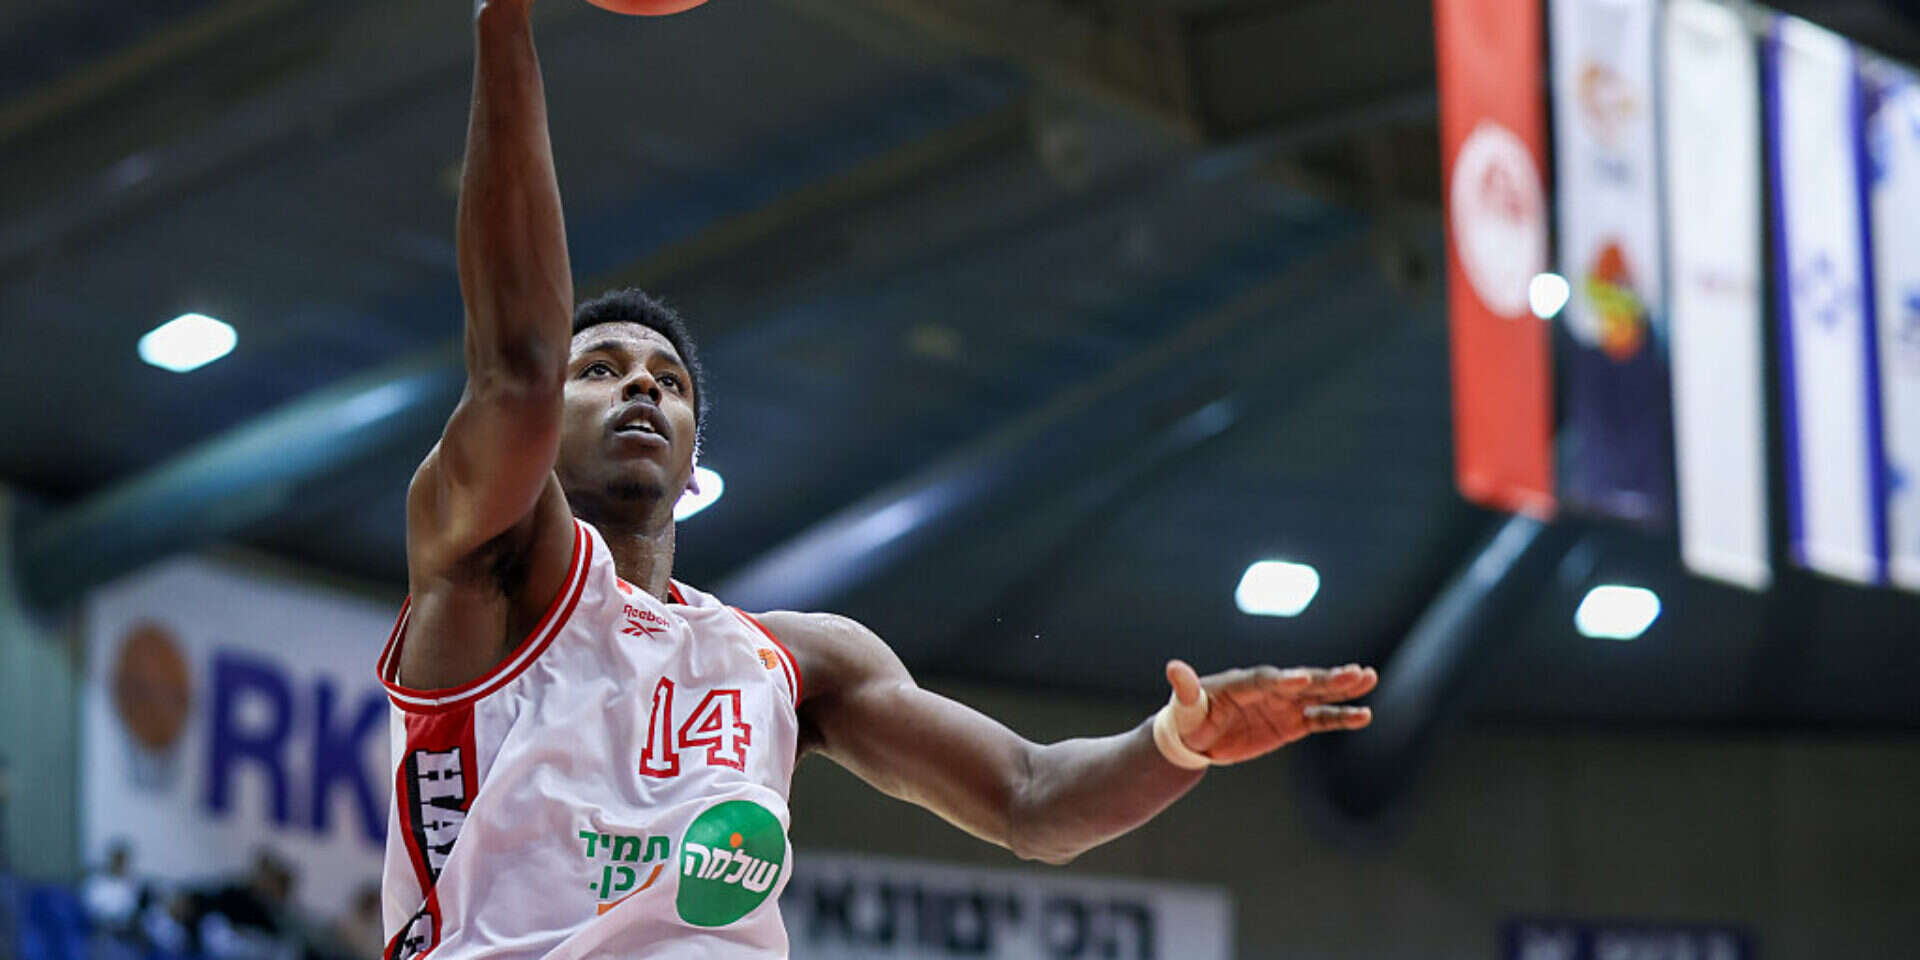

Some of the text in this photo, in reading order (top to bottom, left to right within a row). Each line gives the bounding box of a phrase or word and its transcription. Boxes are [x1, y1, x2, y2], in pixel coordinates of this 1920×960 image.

[640, 676, 752, 778] 14
[578, 830, 670, 863] תמיד
[683, 842, 779, 893] שלמה
